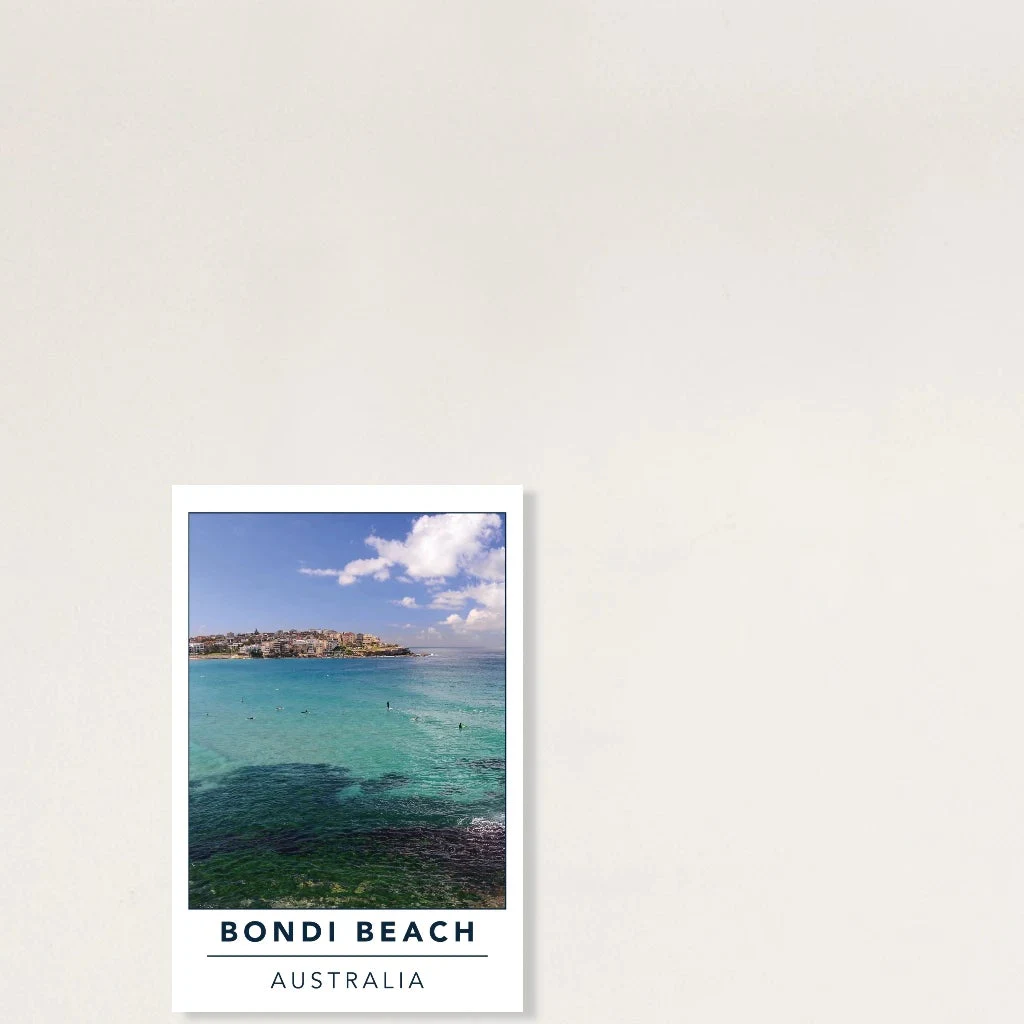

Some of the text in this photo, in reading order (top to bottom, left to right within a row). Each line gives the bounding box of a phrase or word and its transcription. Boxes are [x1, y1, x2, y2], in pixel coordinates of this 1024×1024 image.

[220, 921, 474, 943] BONDI BEACH
[270, 971, 425, 990] AUSTRALIA
